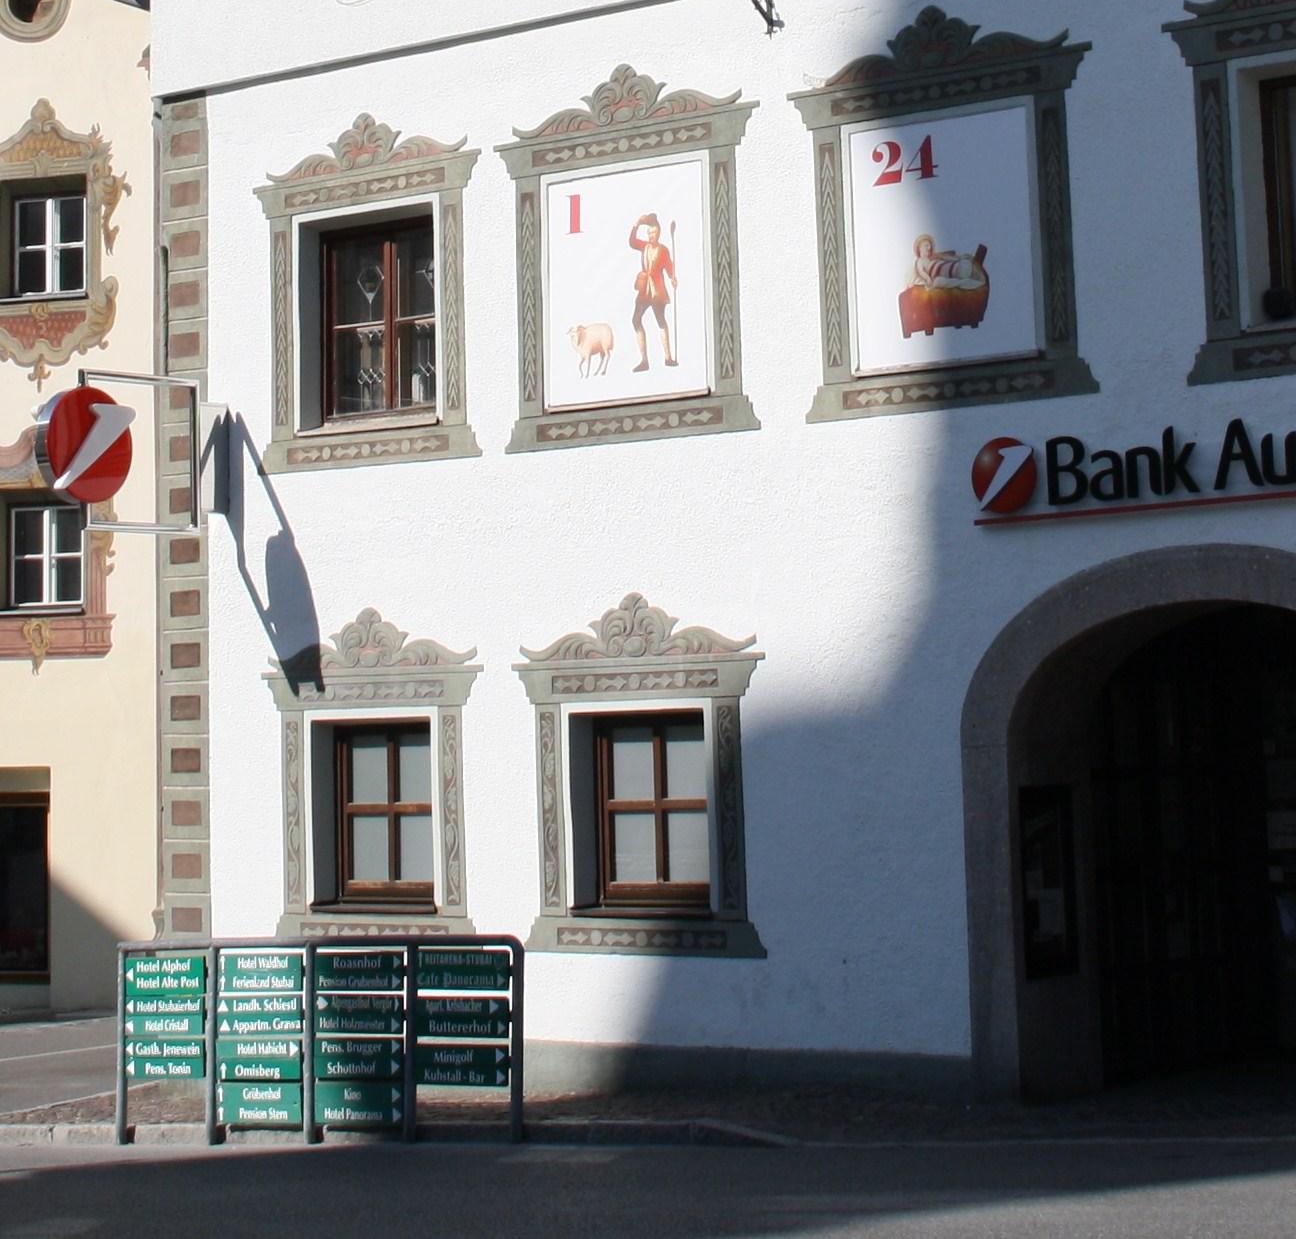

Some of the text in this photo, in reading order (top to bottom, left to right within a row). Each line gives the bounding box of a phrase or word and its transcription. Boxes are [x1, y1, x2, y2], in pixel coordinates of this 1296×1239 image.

[872, 134, 939, 187] 24
[565, 194, 584, 235] 1
[1045, 426, 1201, 506] Bank
[136, 958, 191, 974] Hotel Alphof
[237, 955, 289, 969] Hotel Waldhof
[136, 975, 199, 989] Hotel Alte Post
[271, 975, 295, 989] Stubai
[136, 999, 157, 1013] Hotel
[233, 998, 262, 1012] Landh.
[145, 1019, 164, 1032] Hotel
[232, 1019, 272, 1034] Appartm.
[135, 1041, 162, 1055] Gasth.
[237, 1041, 257, 1055] Hotel
[321, 1041, 383, 1056] Pens. Brugger
[433, 1048, 475, 1064] Minigolf
[145, 1062, 167, 1075] Pens.
[234, 1063, 281, 1080] Omisberg
[424, 1066, 462, 1081] Kuhstall
[468, 1070, 486, 1083] Bar
[239, 1106, 288, 1120] Pension Stern
[324, 1107, 344, 1120] Hotel
